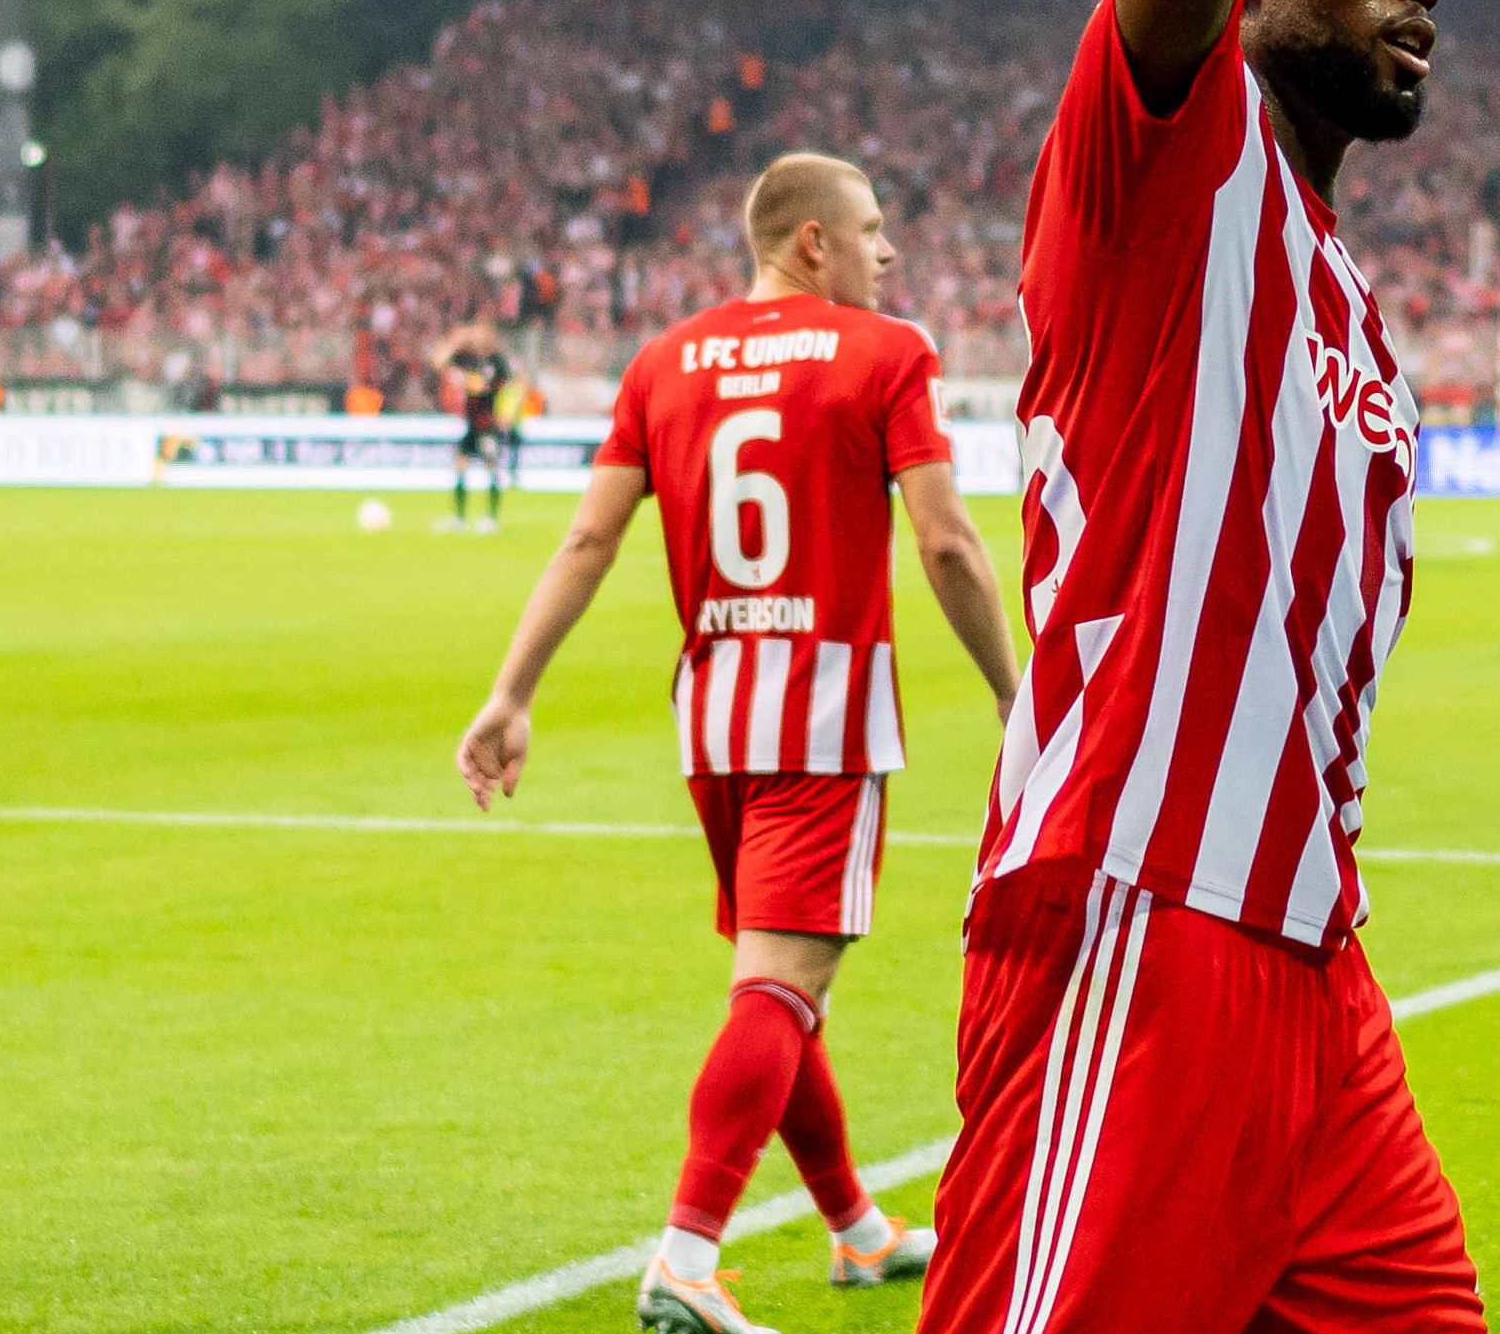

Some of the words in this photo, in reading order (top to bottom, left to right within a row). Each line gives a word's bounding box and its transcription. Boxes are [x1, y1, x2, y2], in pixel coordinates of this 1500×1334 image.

[702, 335, 741, 370] FC
[742, 328, 839, 369] UNION
[708, 407, 791, 590] 6
